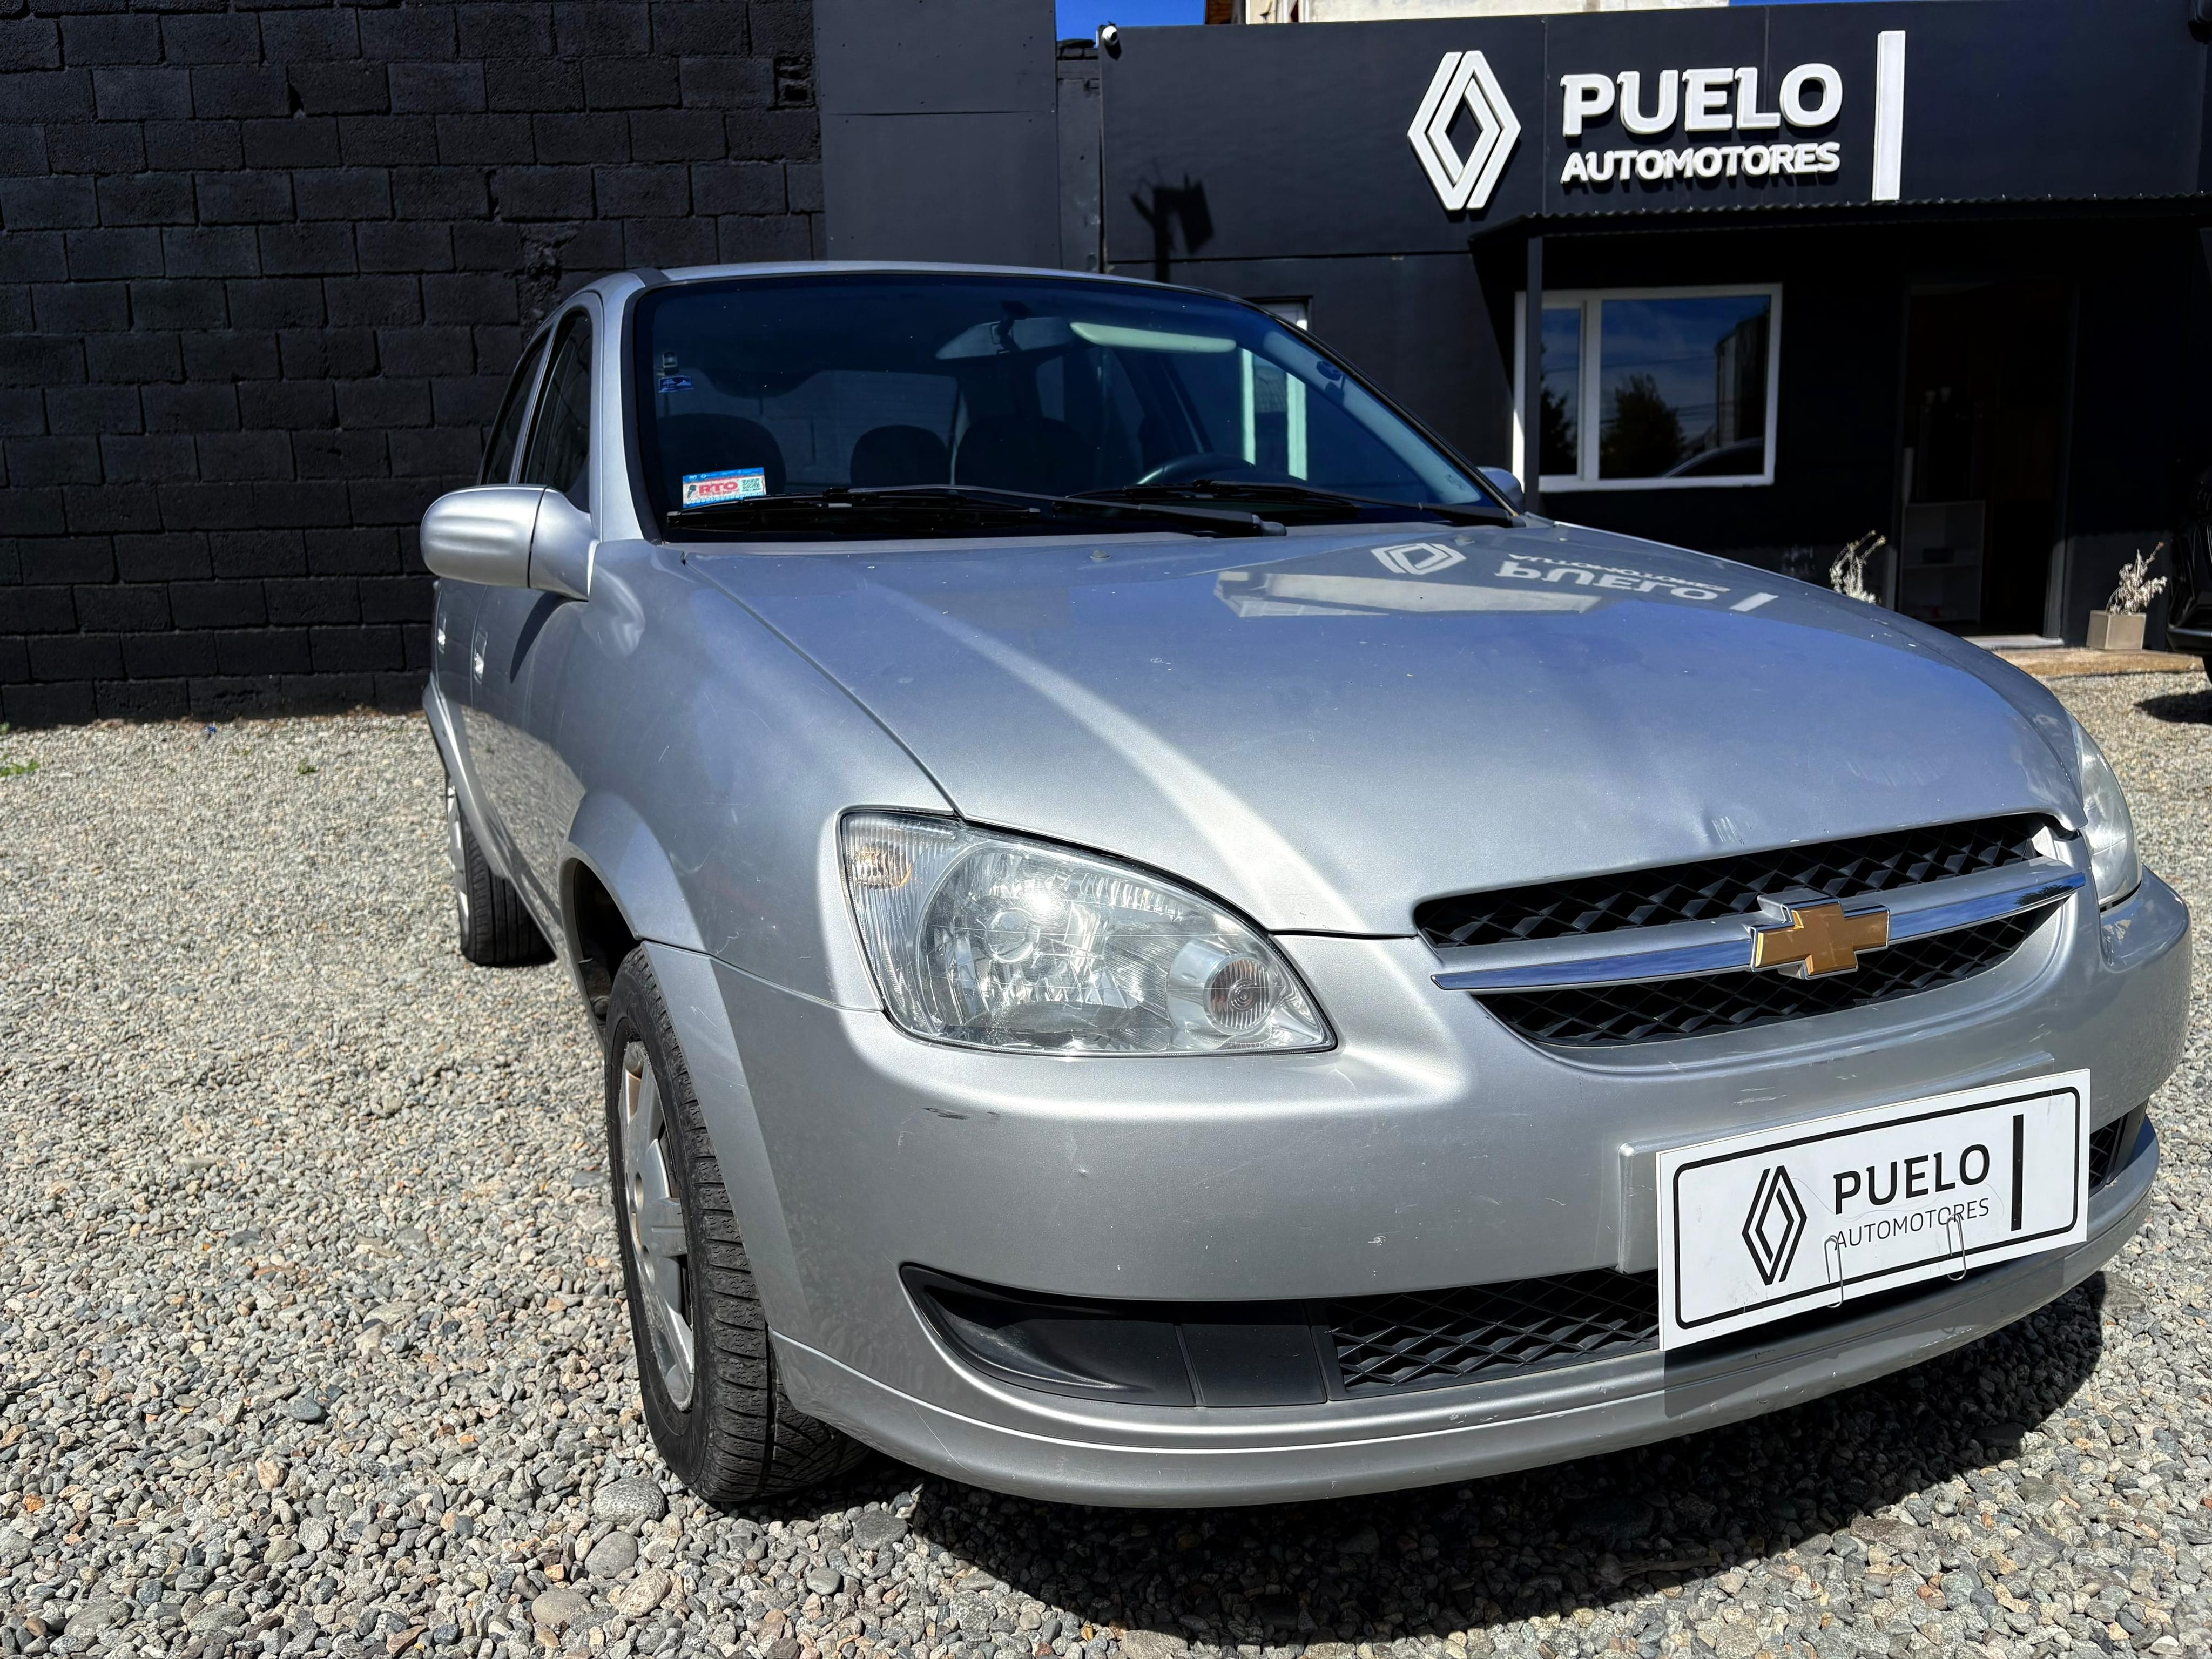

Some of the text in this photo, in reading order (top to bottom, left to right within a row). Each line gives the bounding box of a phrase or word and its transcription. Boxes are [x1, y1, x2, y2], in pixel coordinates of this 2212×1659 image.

[1560, 63, 1843, 137] PUELO
[1561, 142, 1840, 183] AUTOMOTORES
[699, 481, 738, 494] RTO
[1833, 1144, 1990, 1215] PUELO
[1835, 1197, 1989, 1250] AUTOMOTORES
